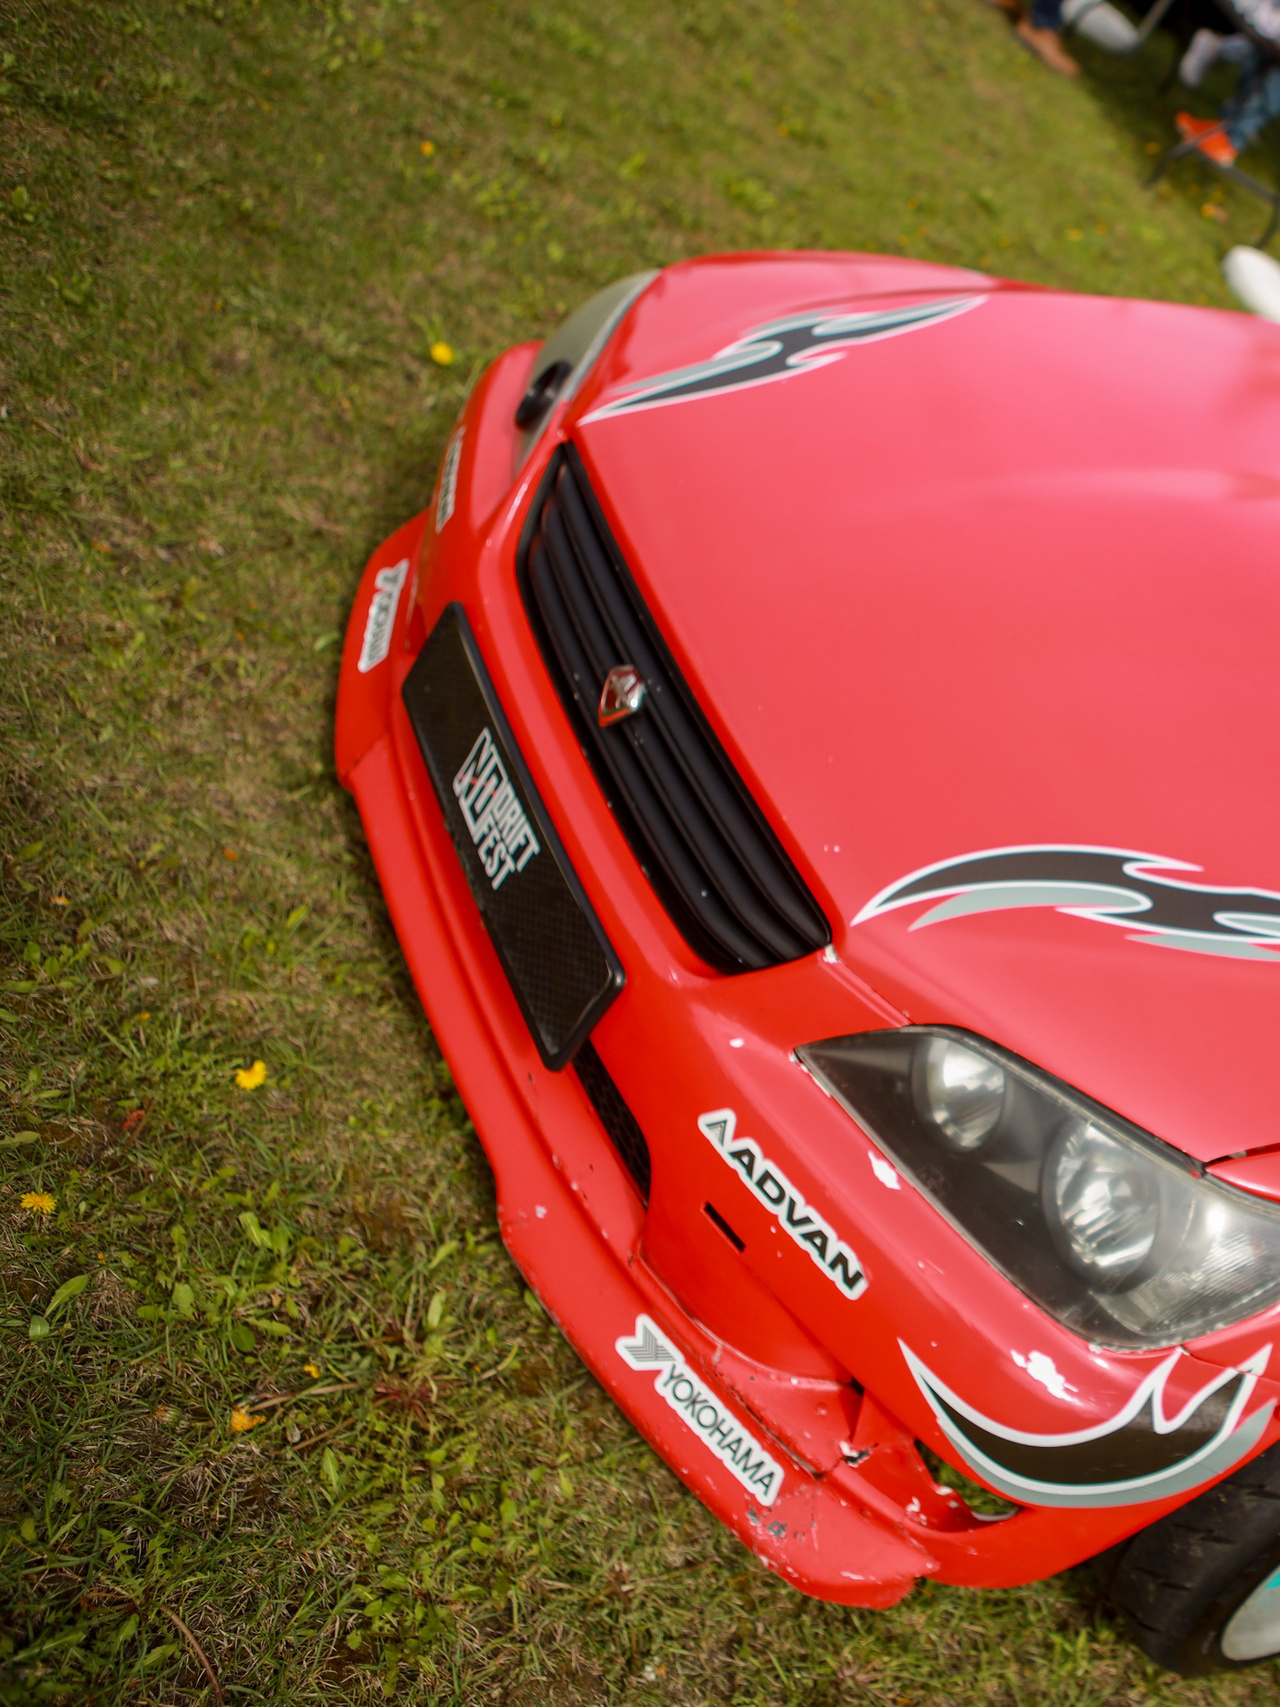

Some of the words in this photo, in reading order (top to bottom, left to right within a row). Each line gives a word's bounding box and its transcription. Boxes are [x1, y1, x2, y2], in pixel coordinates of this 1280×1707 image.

[472, 813, 516, 891] FEST
[493, 782, 541, 873] DRIFT
[729, 1147, 864, 1290] ADVAN
[663, 1363, 776, 1498] YOKOHAMA
